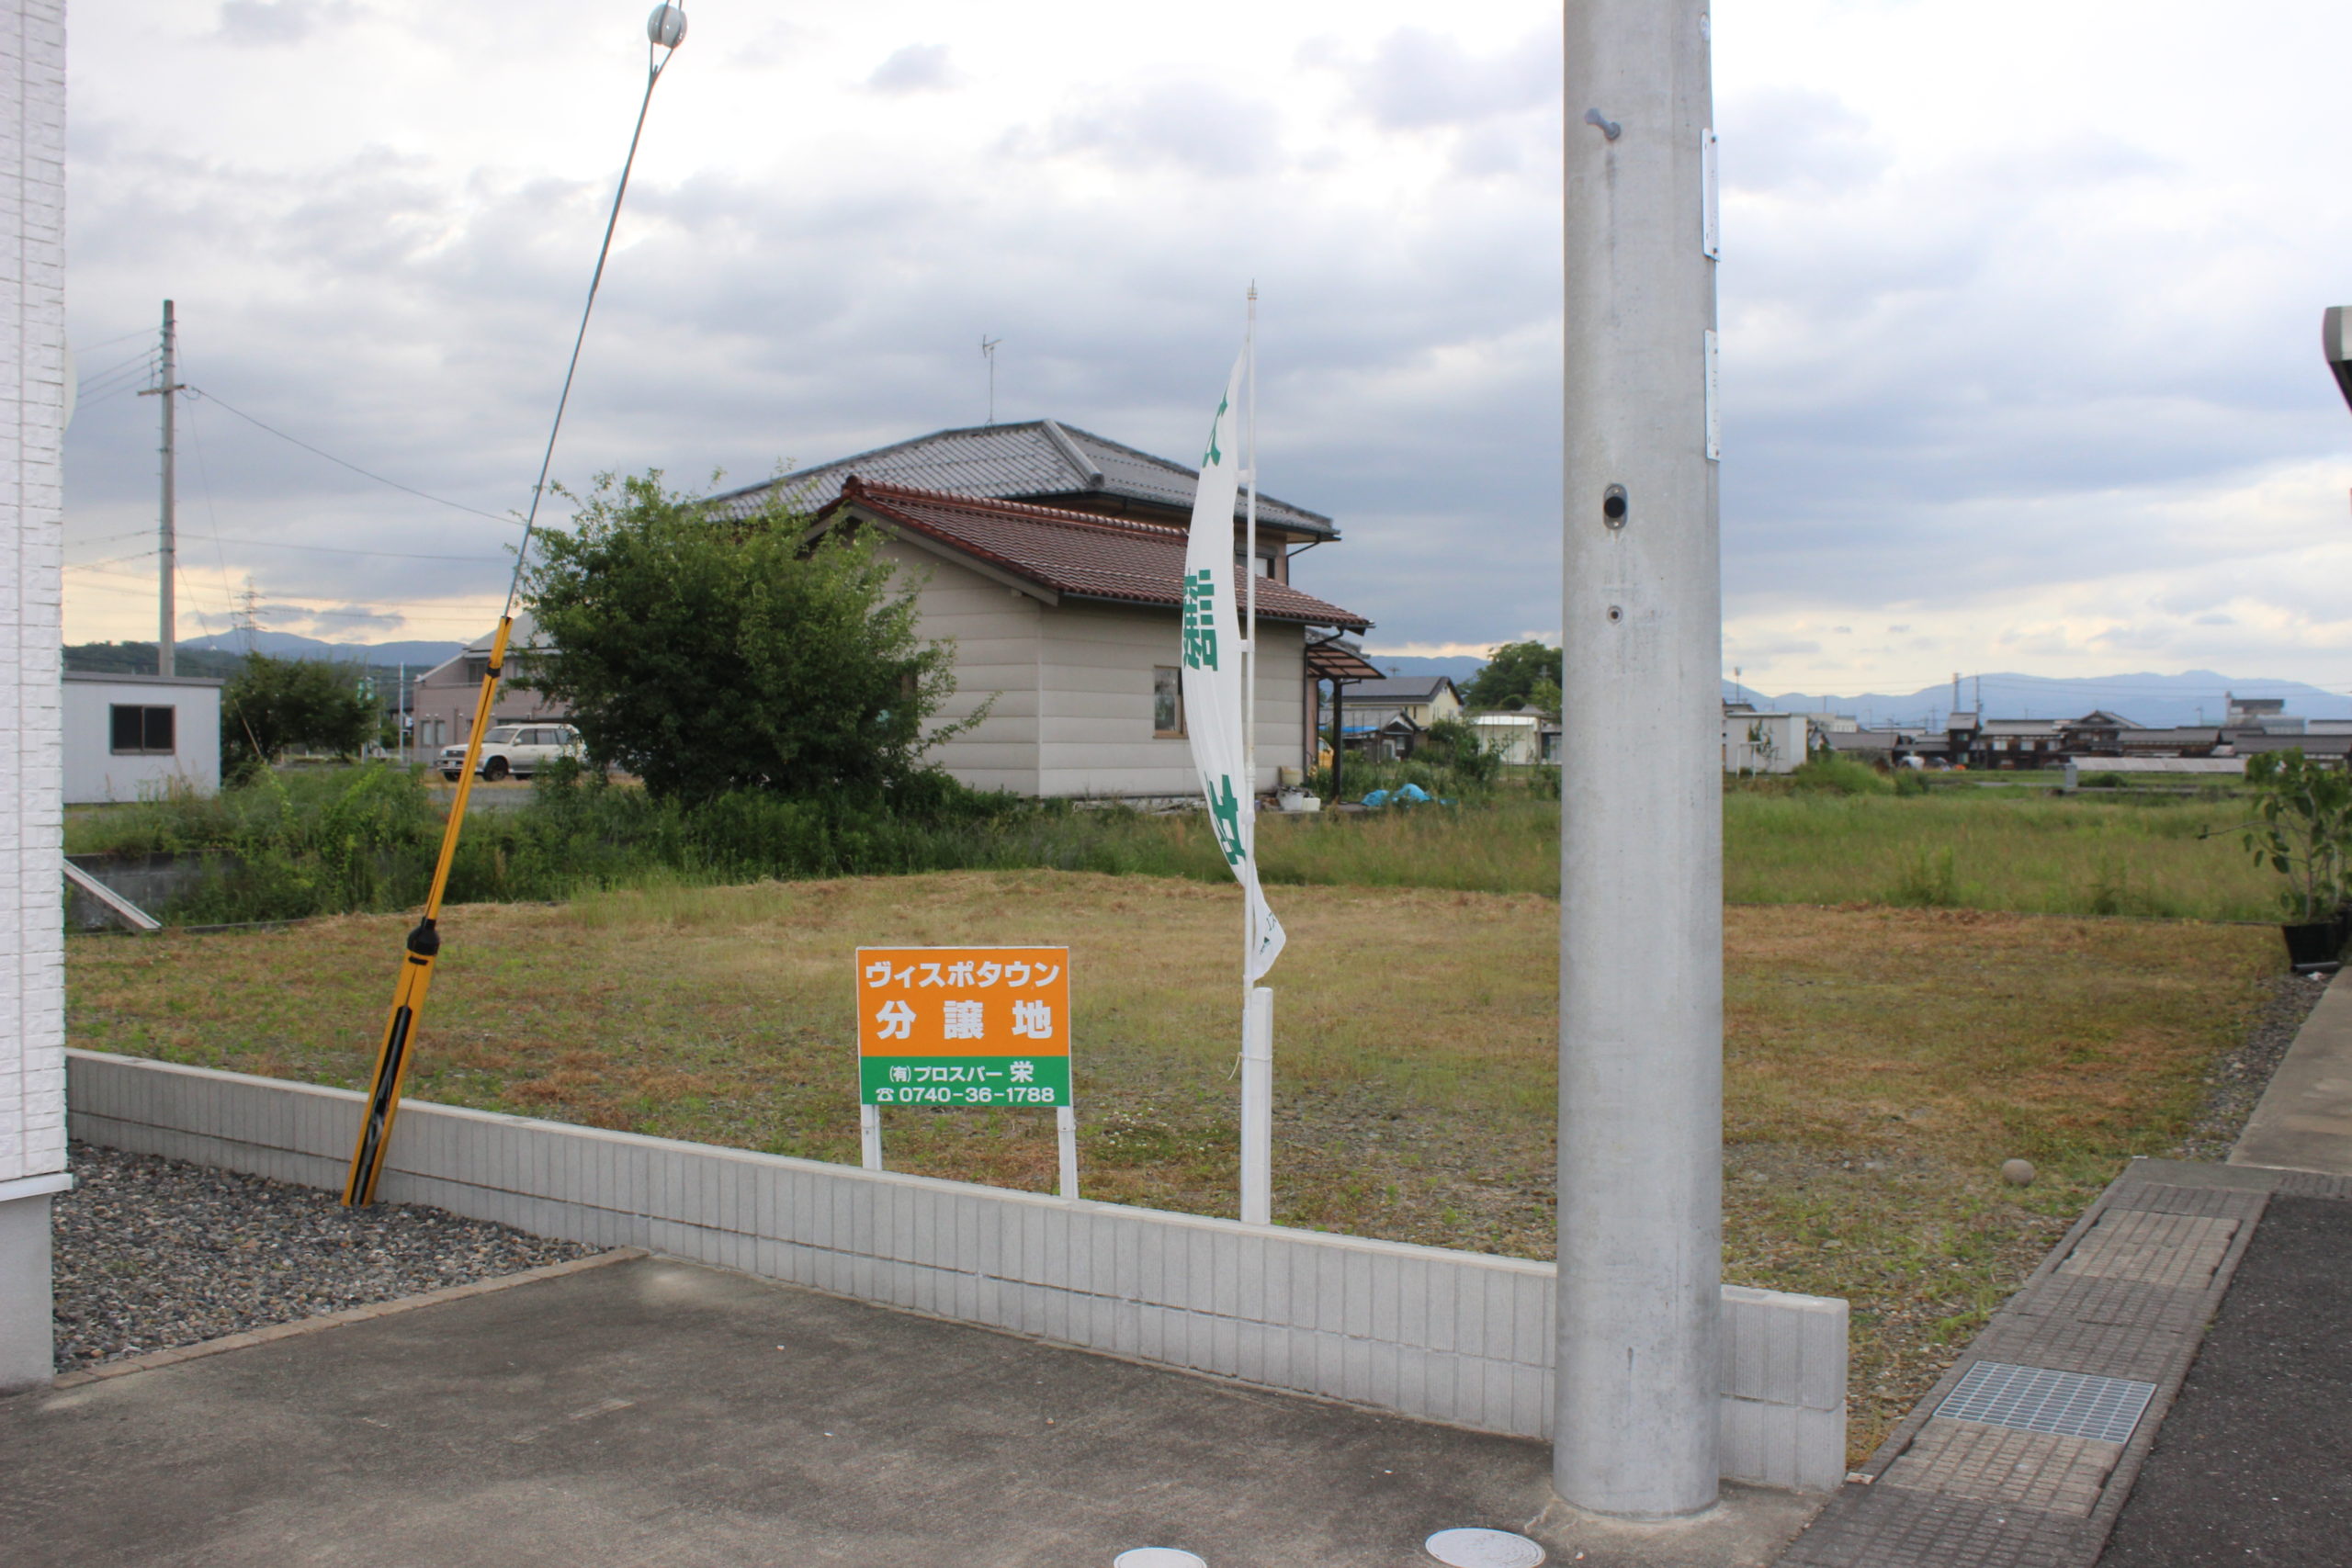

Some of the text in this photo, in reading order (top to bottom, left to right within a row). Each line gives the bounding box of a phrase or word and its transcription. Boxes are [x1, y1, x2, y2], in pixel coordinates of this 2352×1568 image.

[865, 961, 1059, 987] ヴィスポタウン
[876, 999, 1052, 1039] 分譲地
[899, 1088, 1054, 1101] 0740-36-1788
